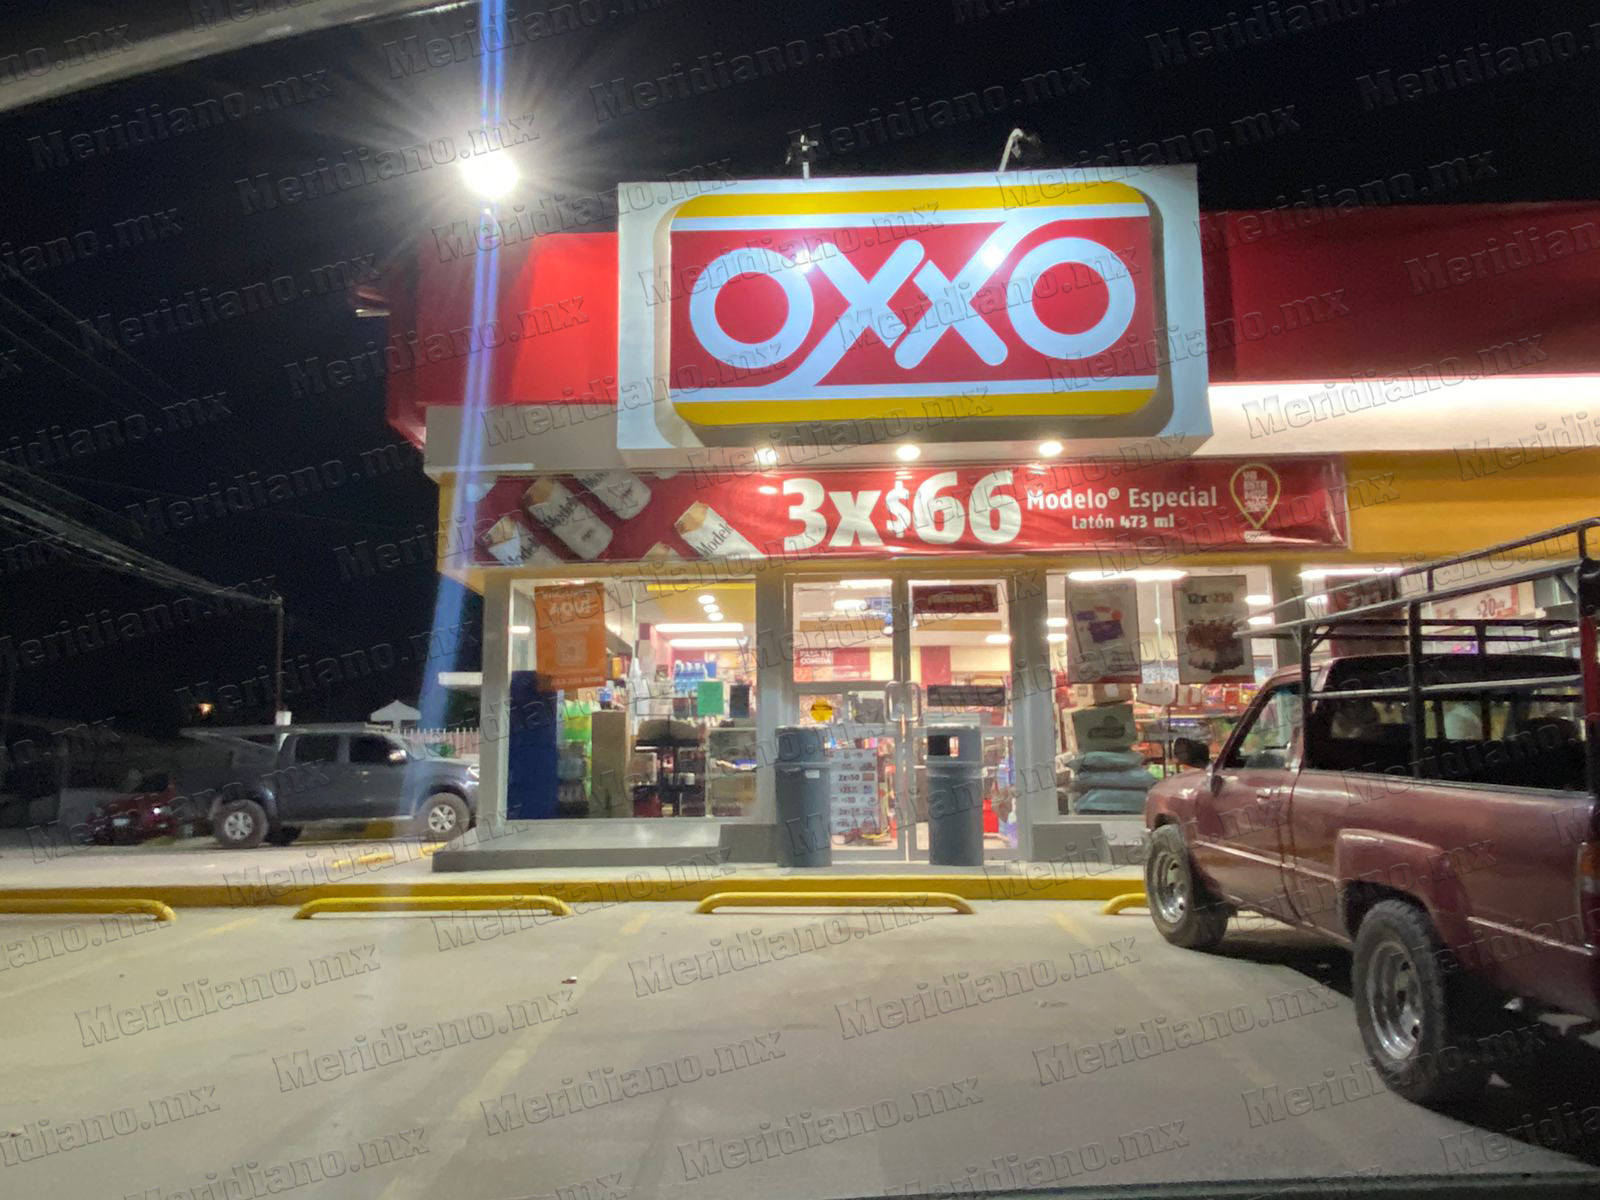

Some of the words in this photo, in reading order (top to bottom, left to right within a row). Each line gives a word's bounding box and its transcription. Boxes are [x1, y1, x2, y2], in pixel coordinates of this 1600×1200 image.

[690, 237, 1135, 368] OXXO
[783, 470, 1022, 551] 3x$66
[1072, 513, 1114, 530] Latón
[1119, 514, 1148, 529] 473
[1154, 513, 1174, 529] ml
[1129, 486, 1217, 509] Especial
